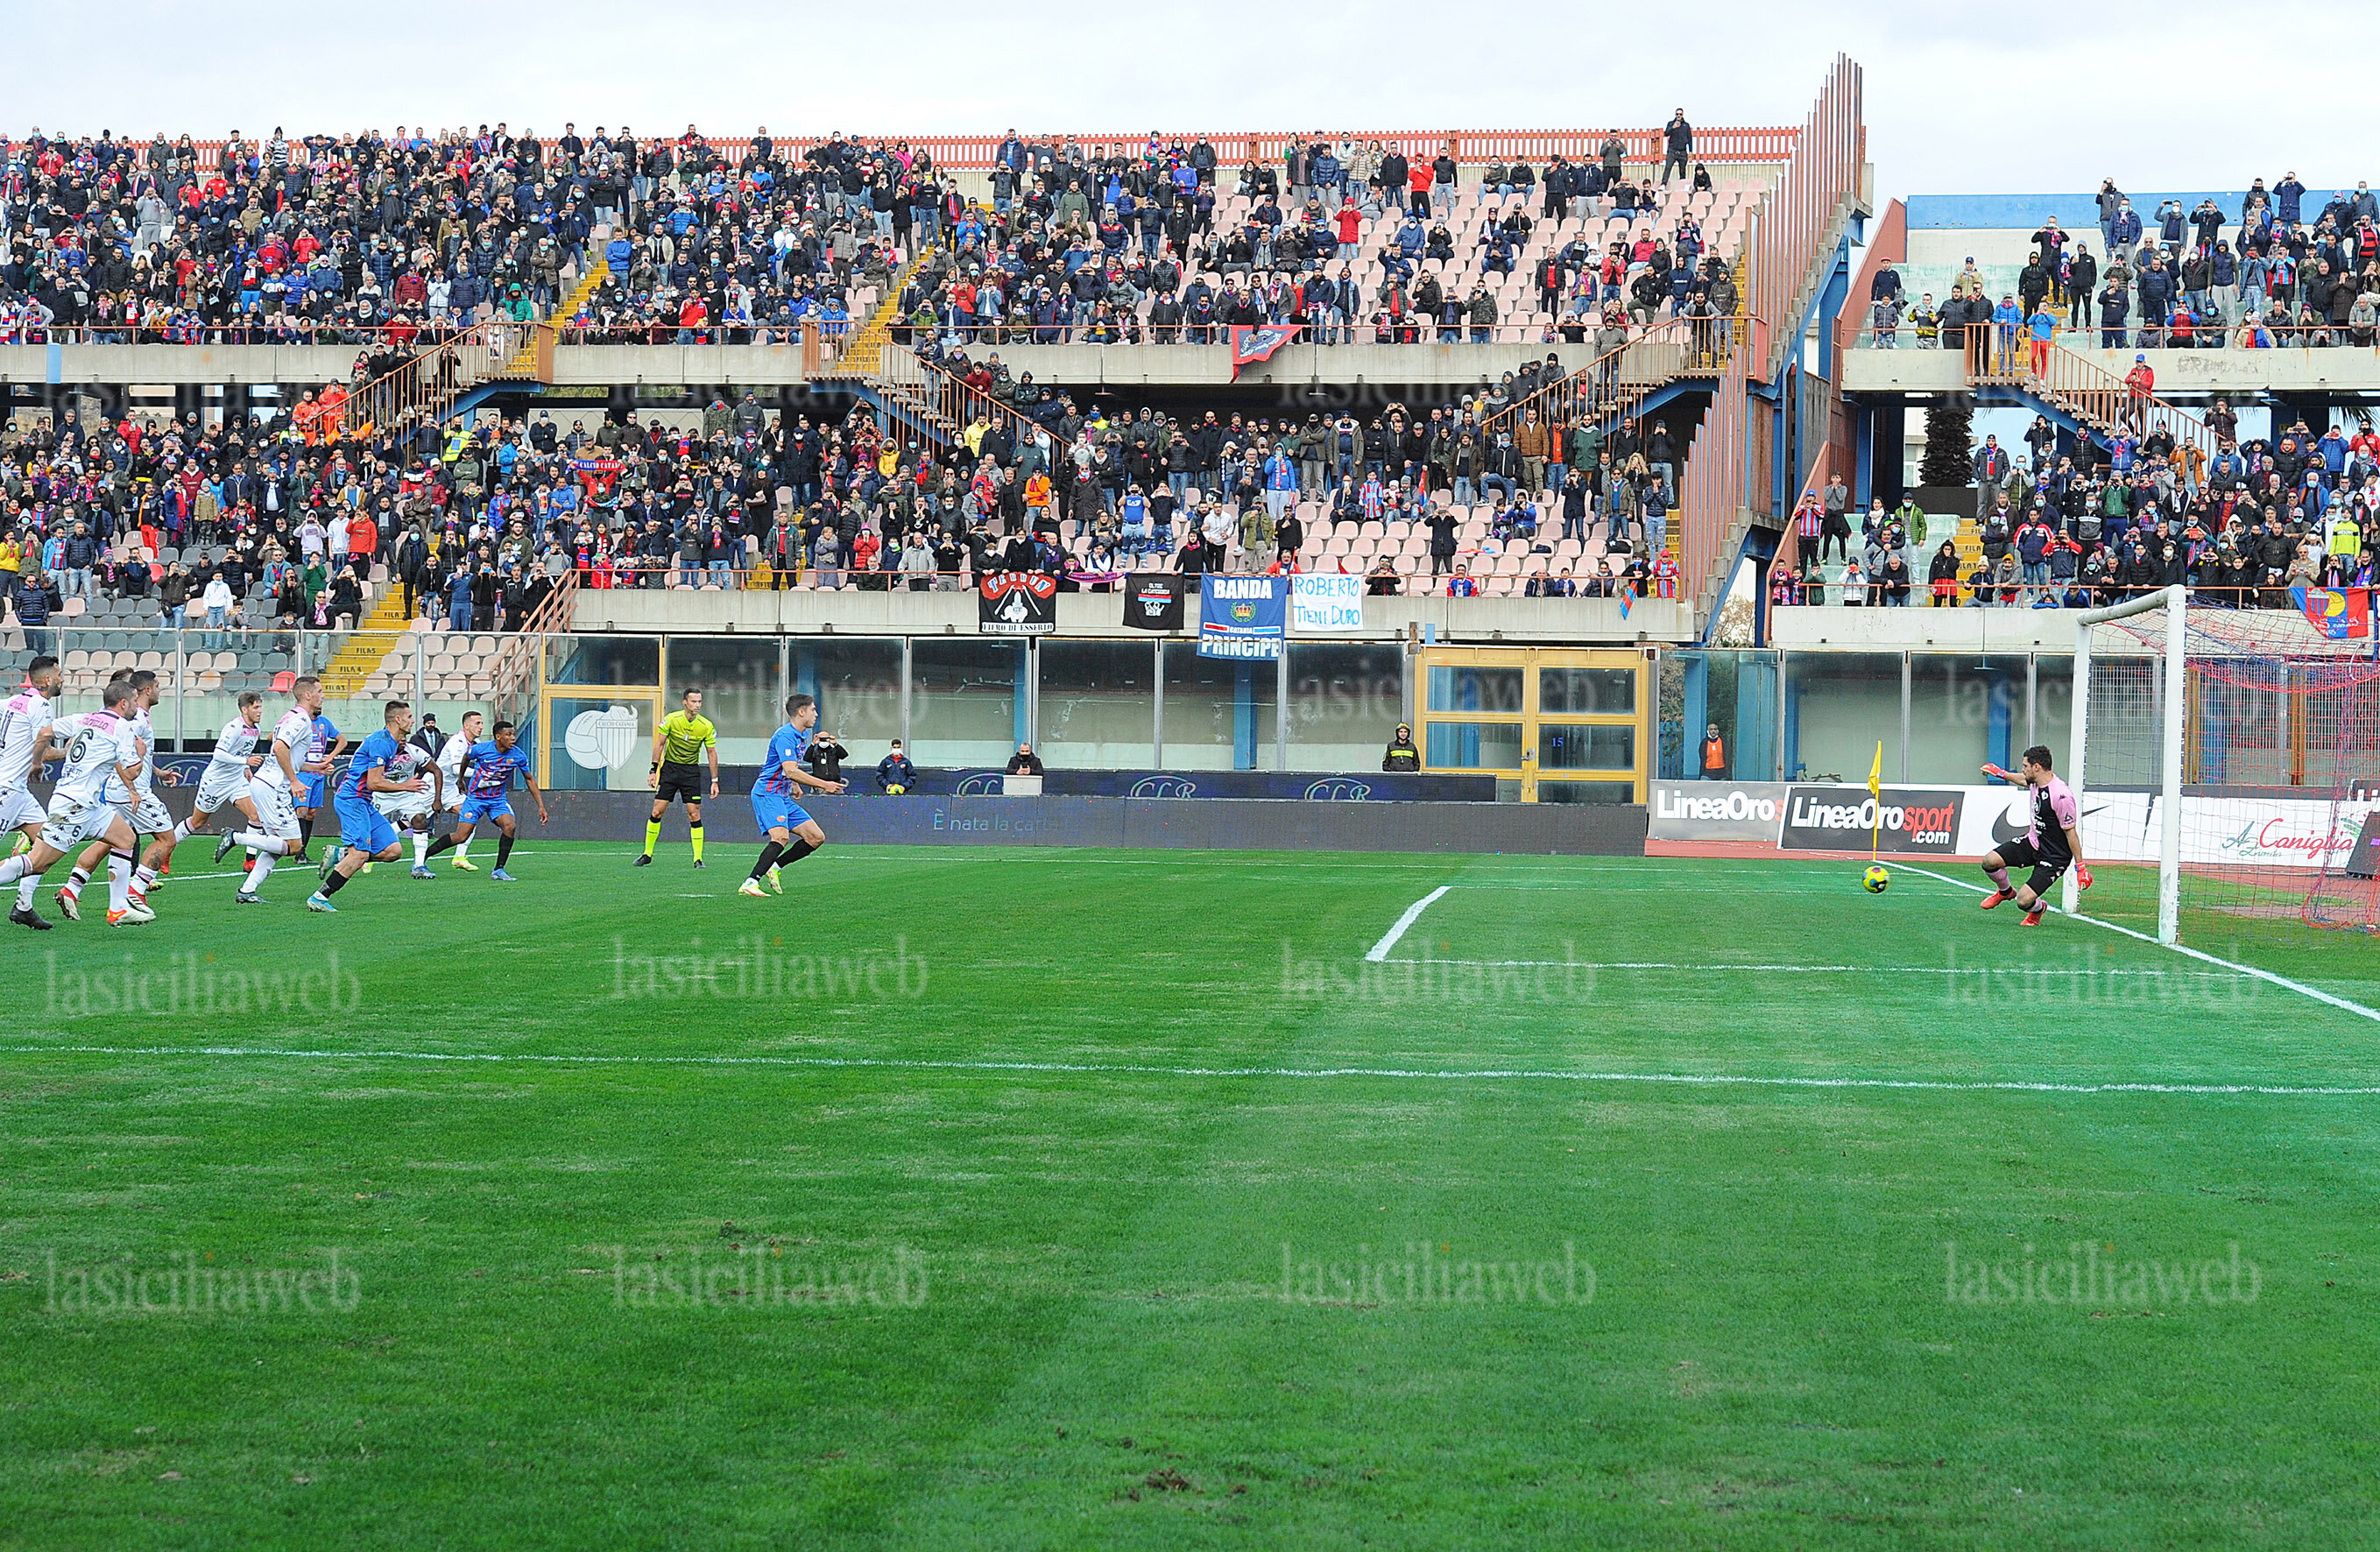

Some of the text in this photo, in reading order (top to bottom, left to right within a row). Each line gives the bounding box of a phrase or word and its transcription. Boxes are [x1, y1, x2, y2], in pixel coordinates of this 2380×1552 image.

[1213, 579, 1273, 599] BANDA
[1294, 575, 1359, 597] ROBERTO
[1293, 605, 1360, 625] TIENI DURO
[1201, 633, 1282, 658] PRINCIPE
[70, 728, 94, 764] 6
[1551, 737, 1564, 747] 15
[204, 794, 218, 805] 25
[934, 808, 945, 831] È
[950, 816, 989, 831] nata
[994, 815, 1010, 831] la
[72, 825, 82, 837] 6
[1910, 830, 1950, 845] .com
[2259, 818, 2355, 859] Caniglia
